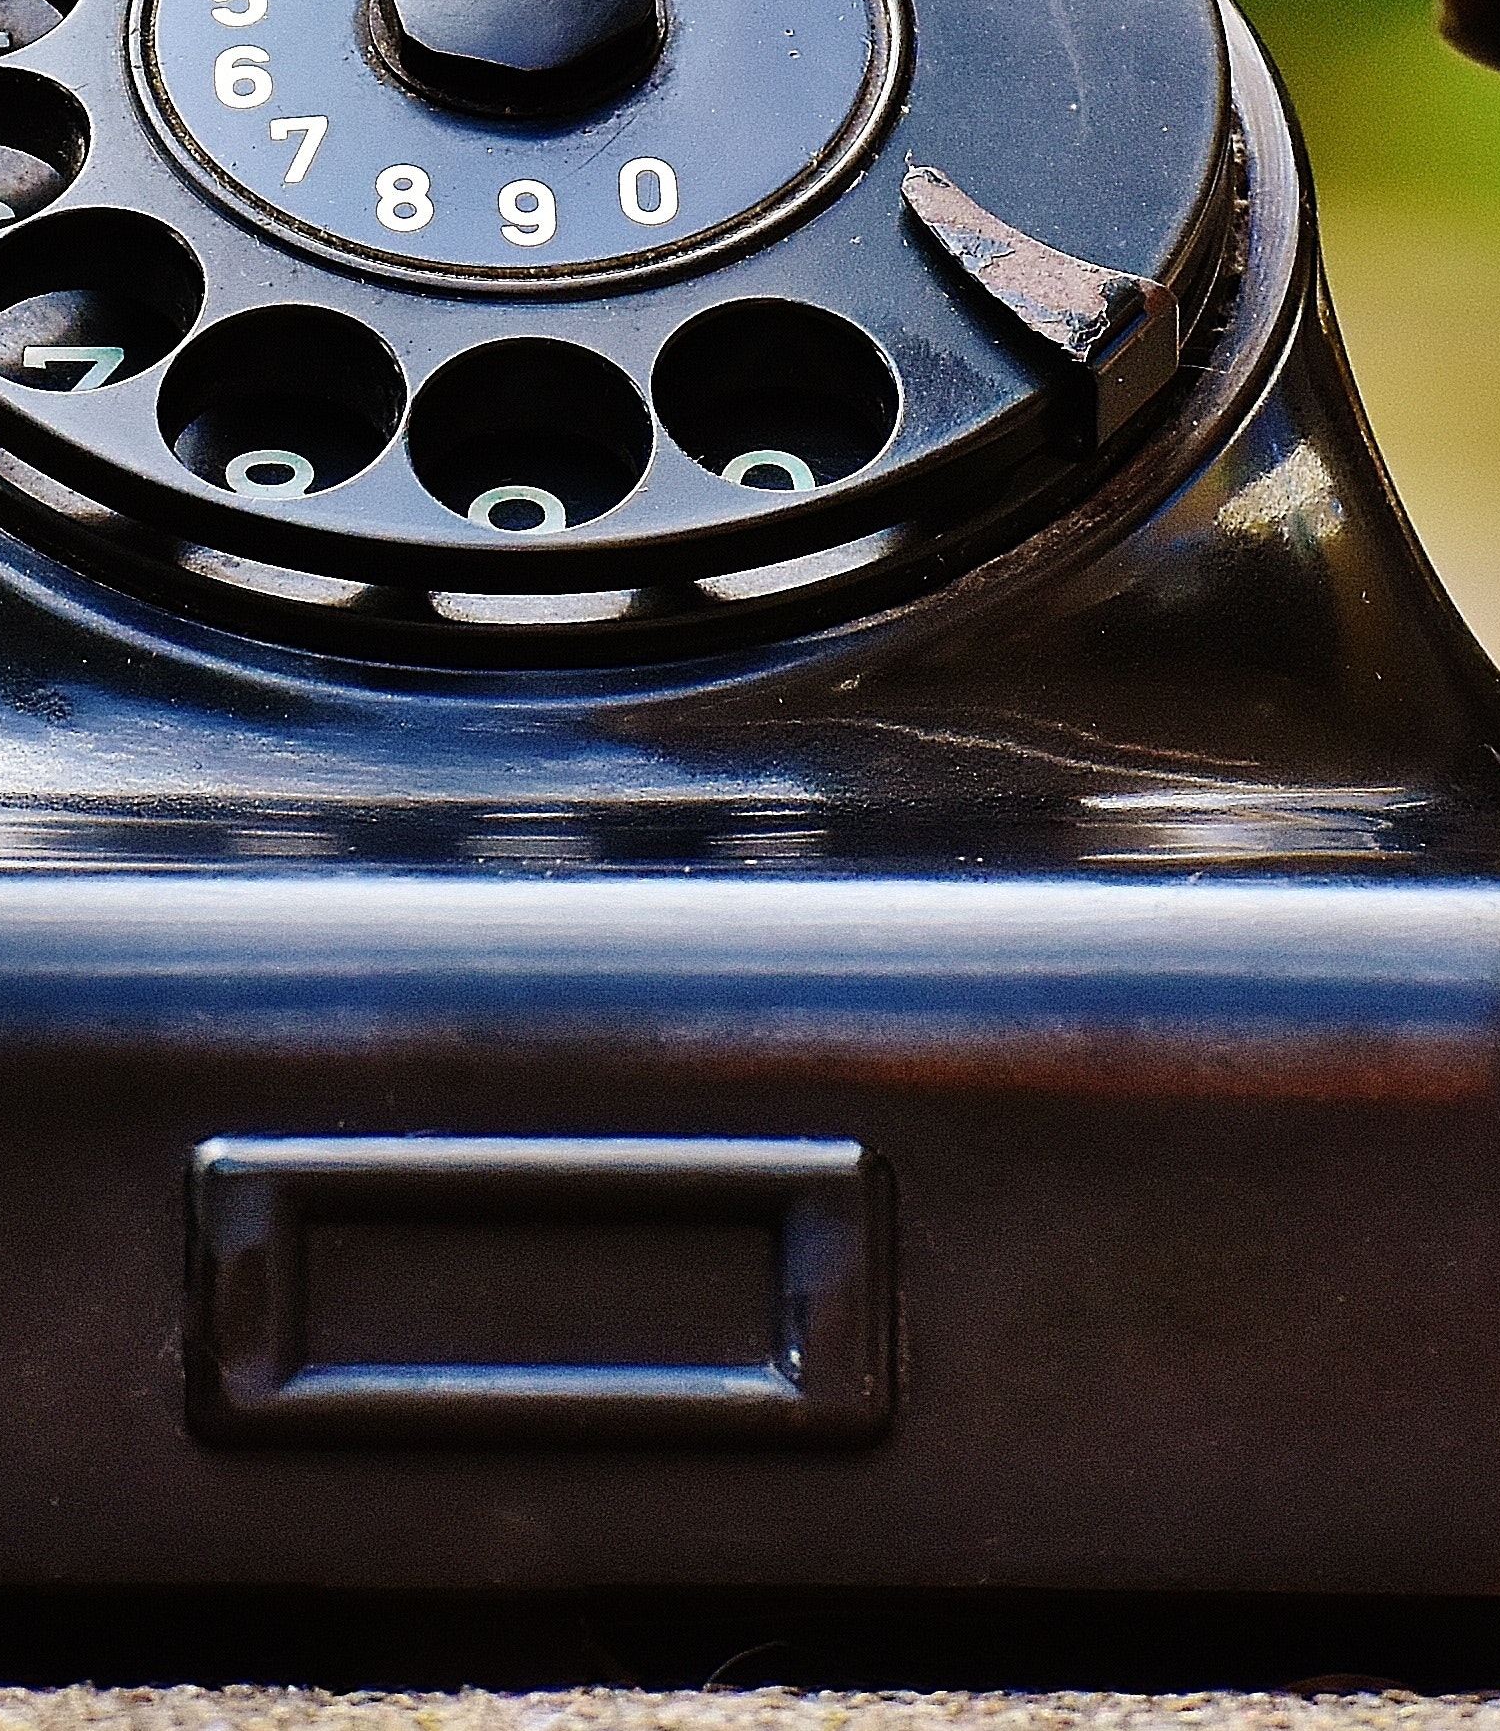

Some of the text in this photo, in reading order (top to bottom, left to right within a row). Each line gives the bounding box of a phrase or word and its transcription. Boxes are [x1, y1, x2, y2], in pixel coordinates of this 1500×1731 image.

[214, 45, 273, 109] 6
[270, 115, 328, 183] 7
[375, 164, 434, 232] 8
[498, 179, 557, 247] 9
[619, 157, 678, 225] 0
